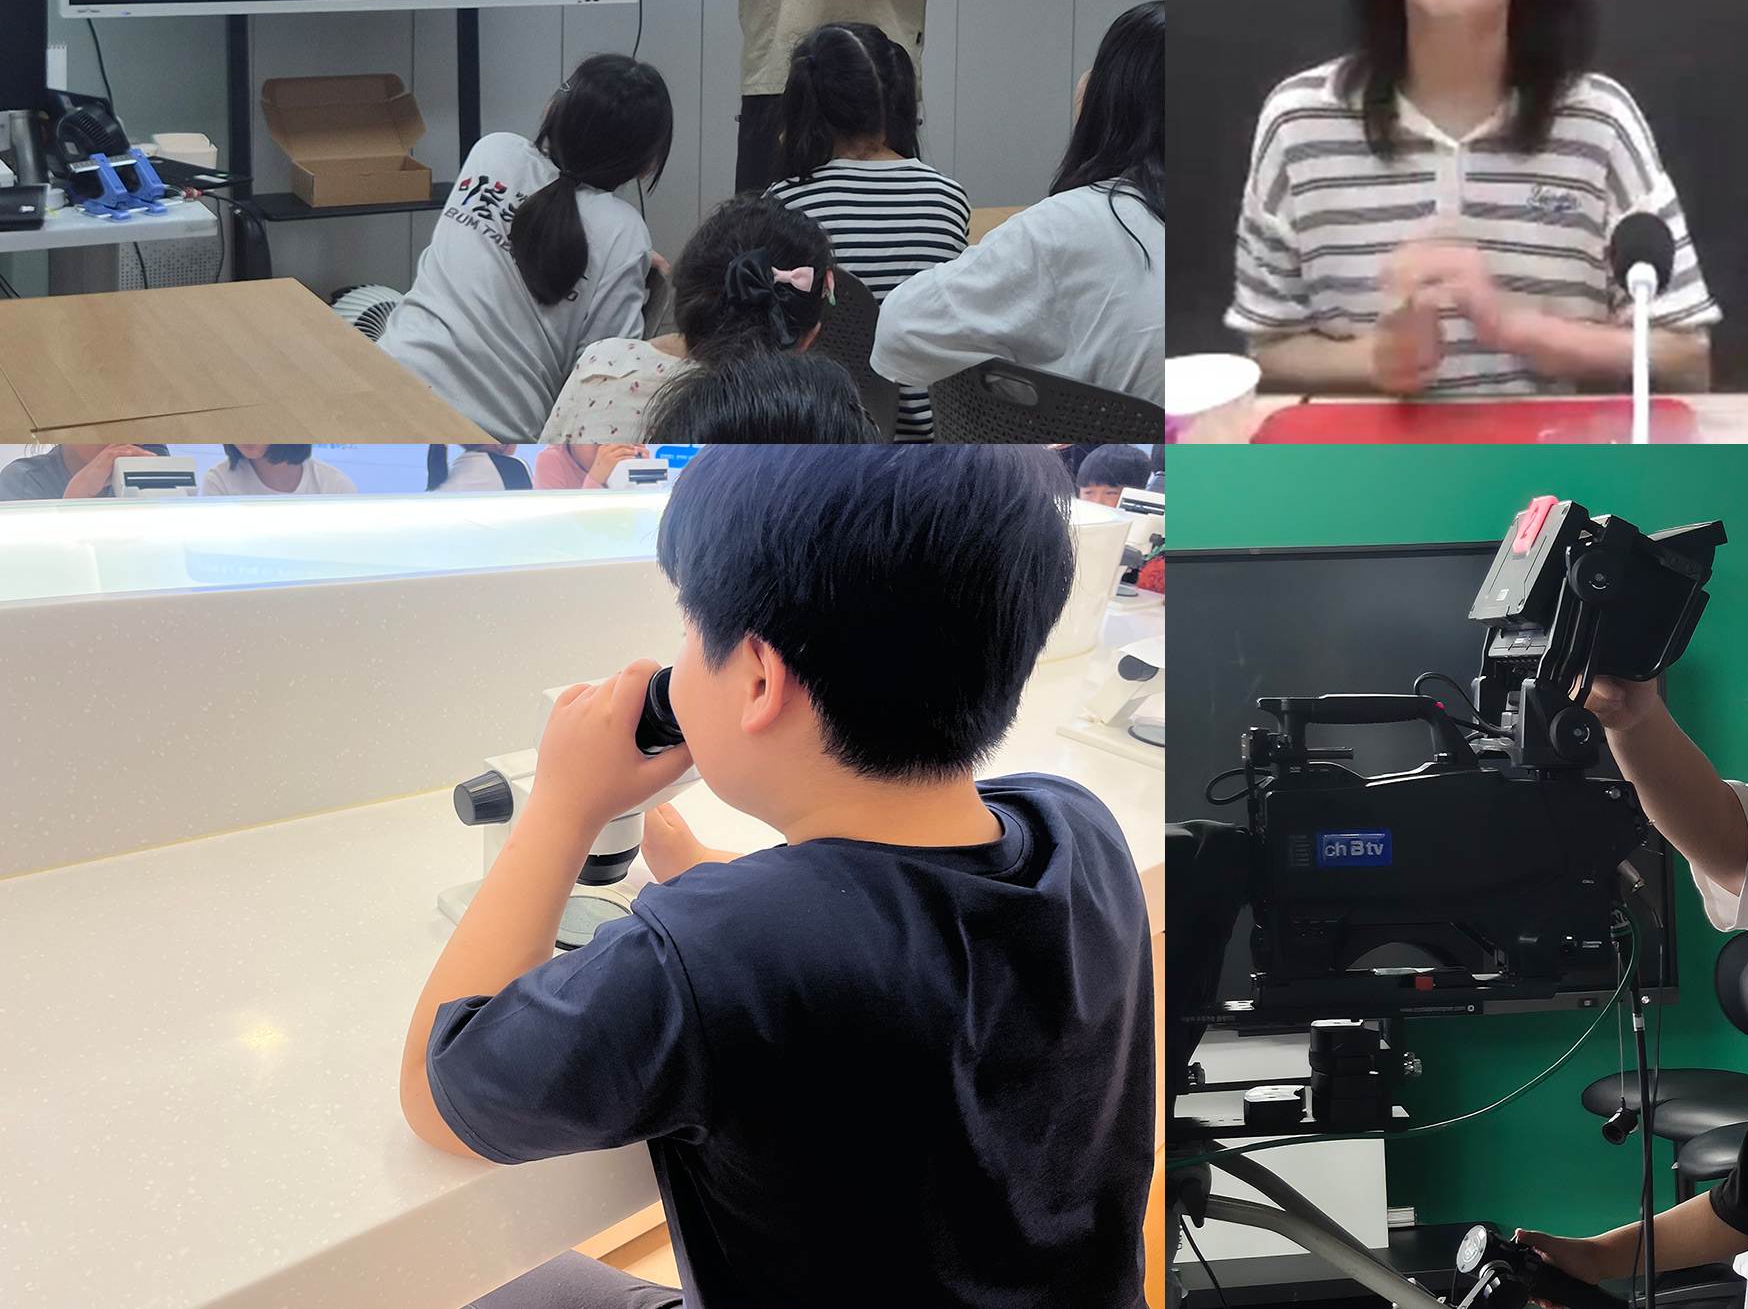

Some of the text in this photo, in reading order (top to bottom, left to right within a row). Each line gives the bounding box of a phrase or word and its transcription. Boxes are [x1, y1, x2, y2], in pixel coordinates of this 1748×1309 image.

[444, 207, 479, 231] BUM
[1325, 841, 1347, 857] ch
[1366, 841, 1384, 856] tv
